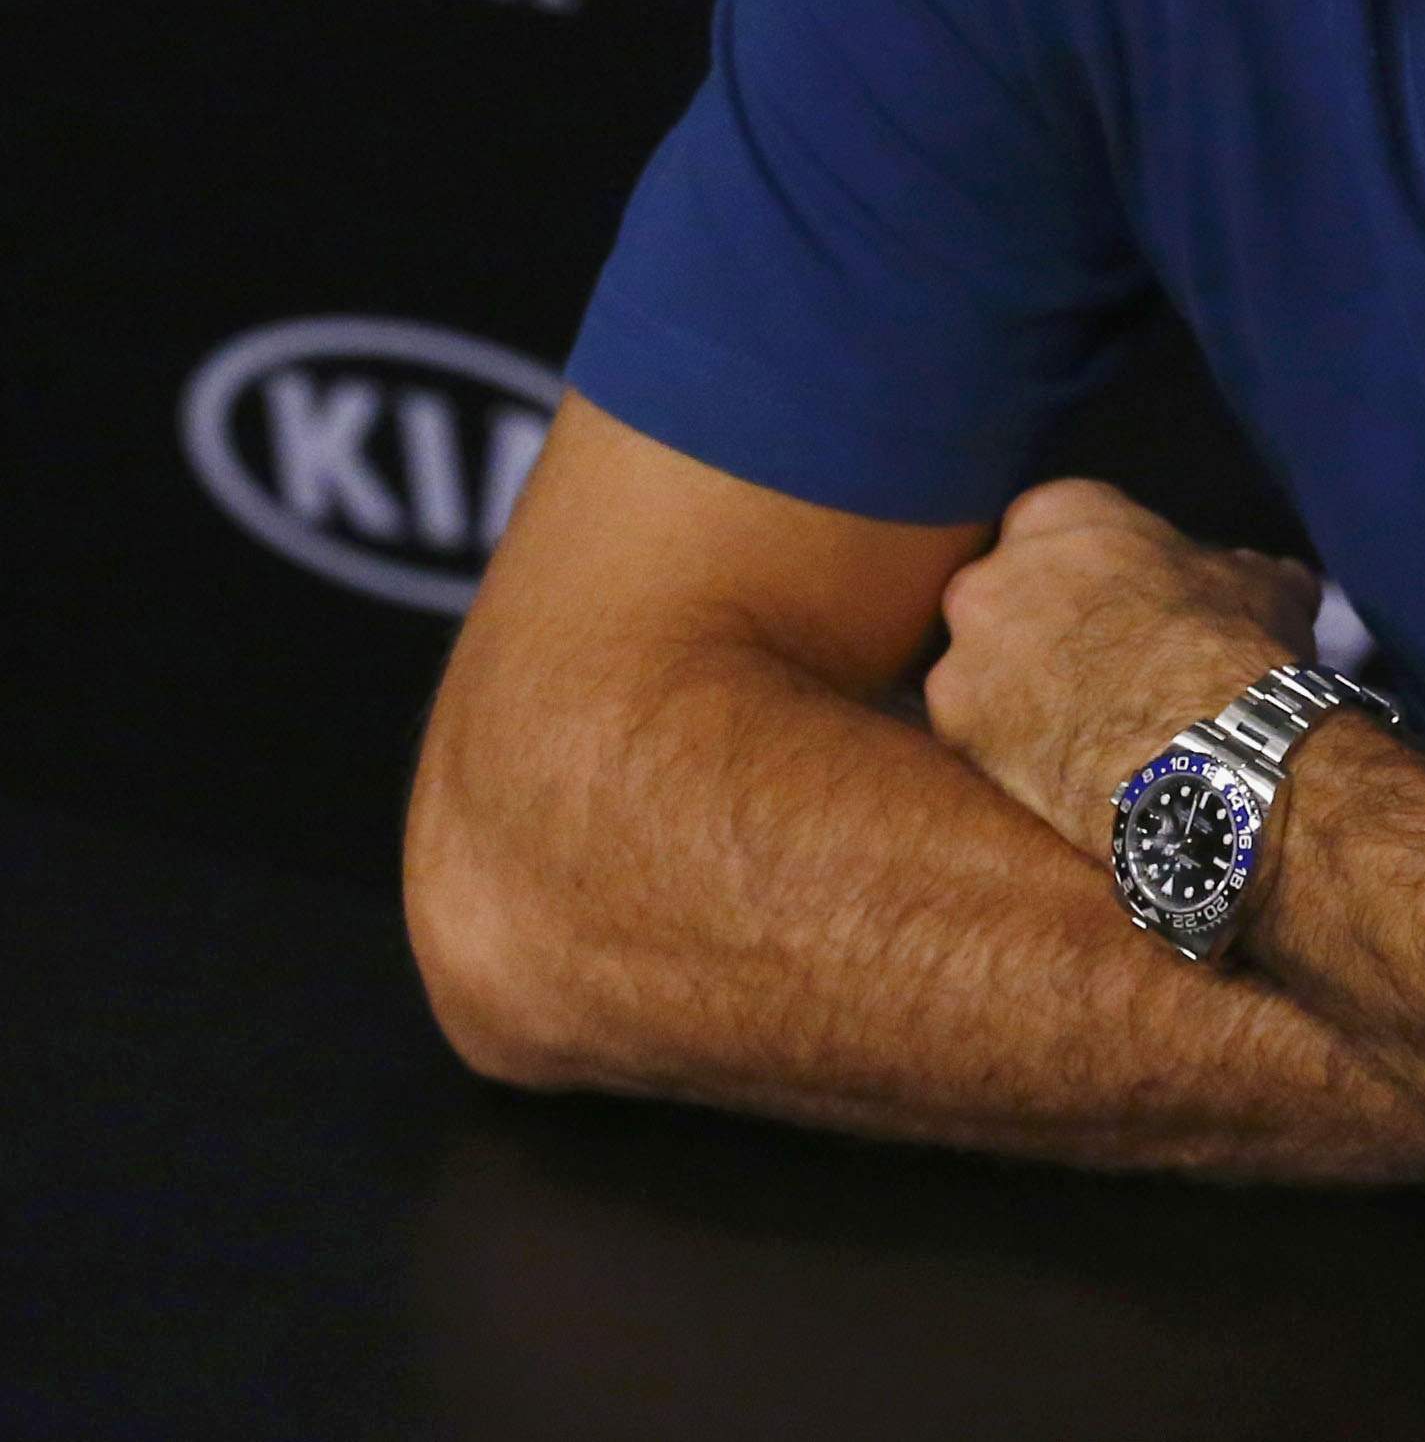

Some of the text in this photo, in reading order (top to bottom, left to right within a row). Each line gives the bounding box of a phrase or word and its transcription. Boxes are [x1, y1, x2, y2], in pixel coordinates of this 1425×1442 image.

[1168, 756, 1190, 771] 10
[1237, 825, 1253, 850] 16
[1229, 867, 1248, 890] 18
